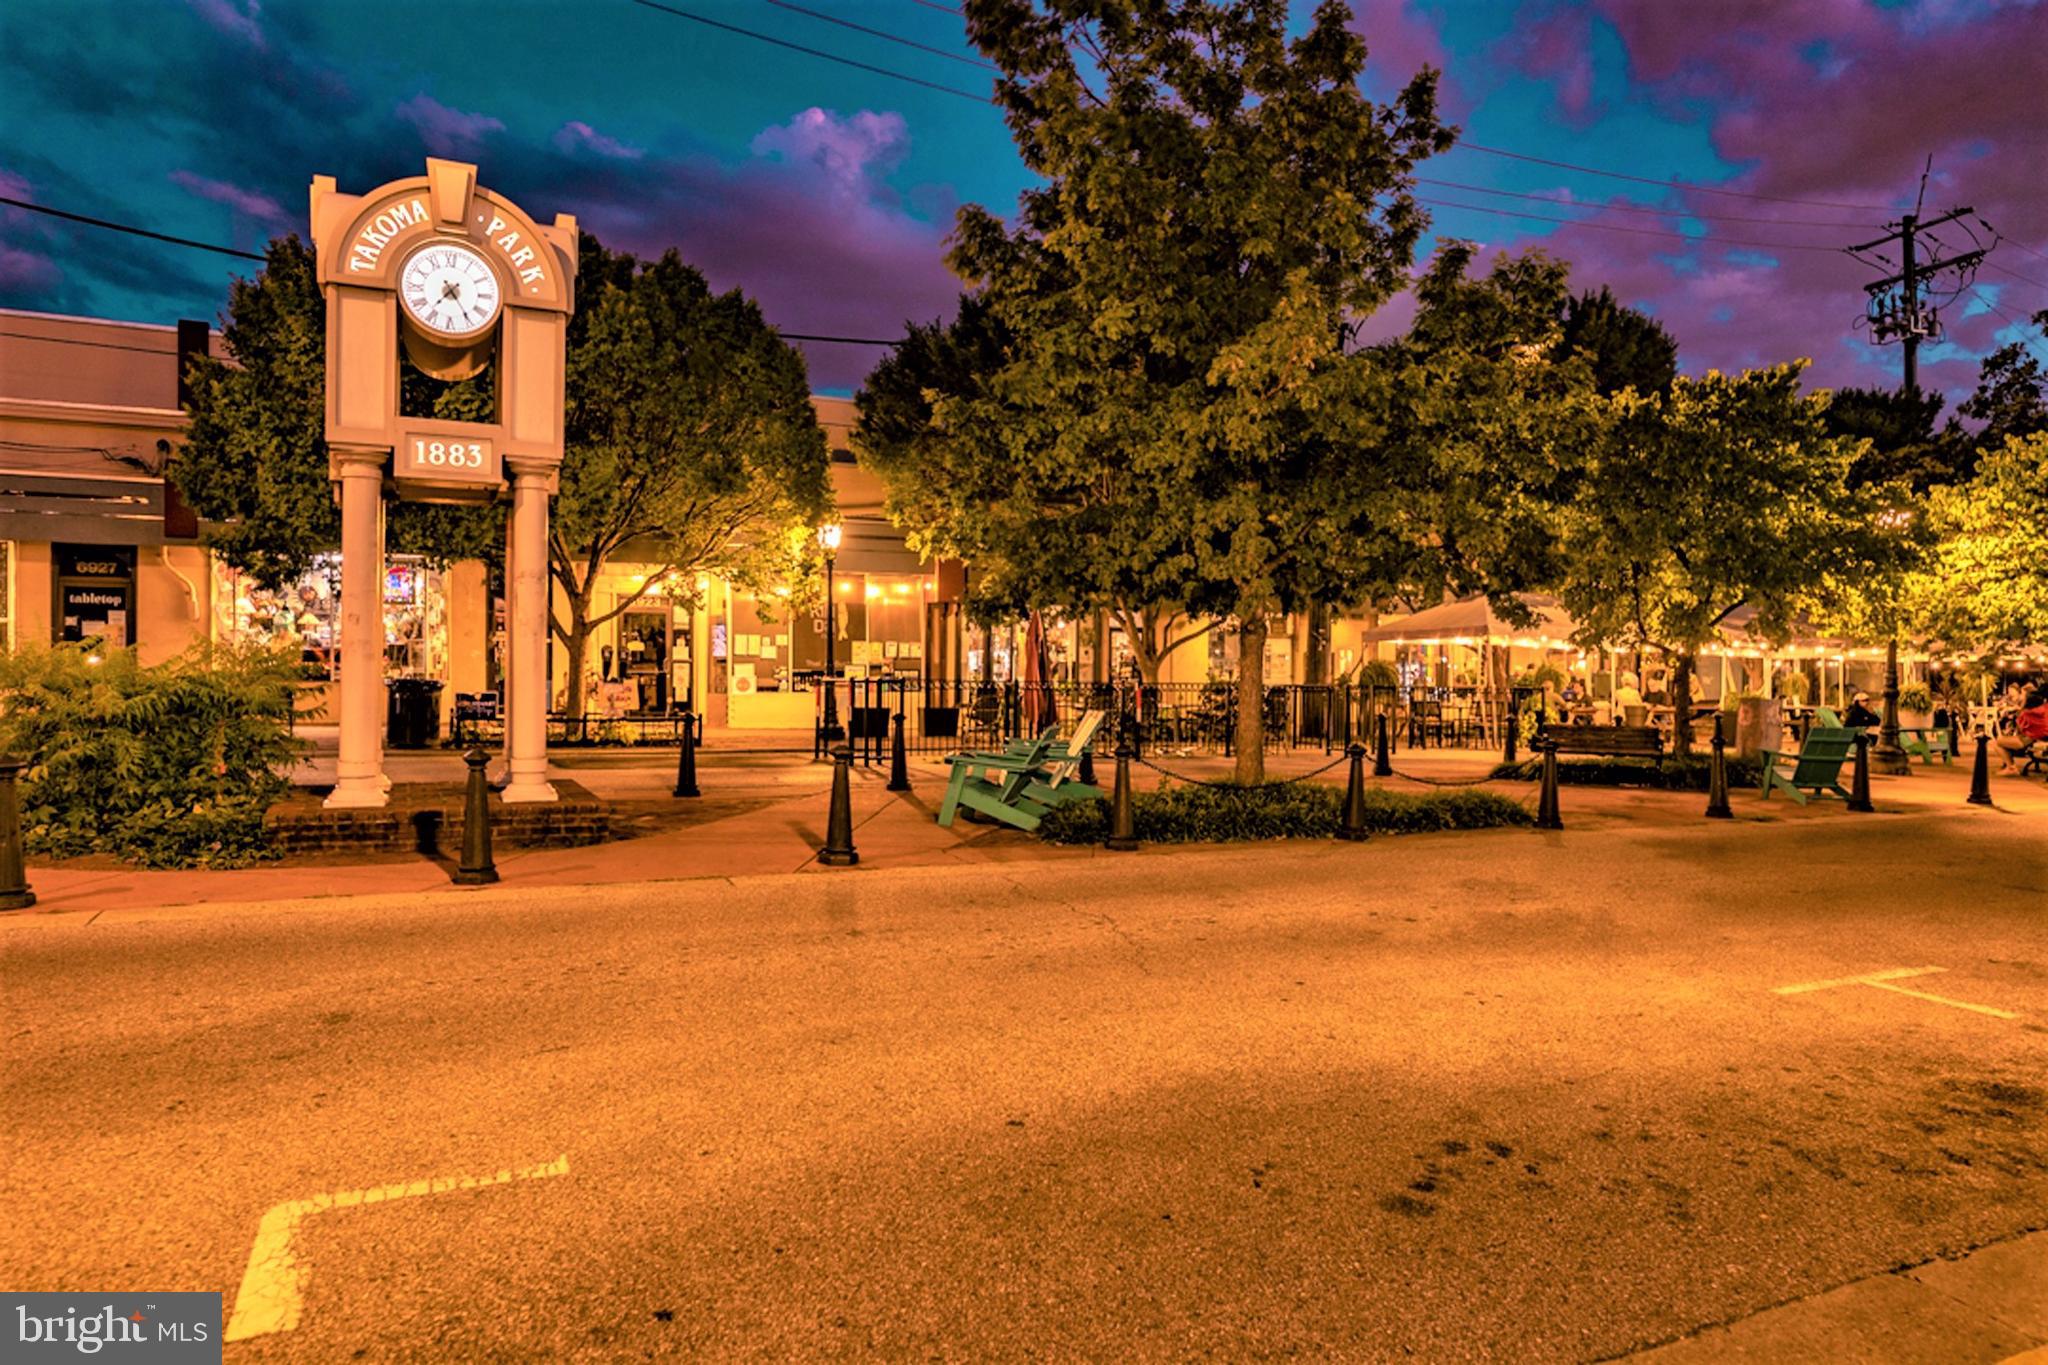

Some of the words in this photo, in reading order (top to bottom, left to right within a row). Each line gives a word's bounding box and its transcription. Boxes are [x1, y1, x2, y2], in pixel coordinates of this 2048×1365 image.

[350, 199, 430, 272] TAKOMA
[485, 216, 545, 284] PARK
[416, 440, 483, 468] 1883
[76, 562, 118, 574] 6927
[69, 593, 122, 607] tabletop
